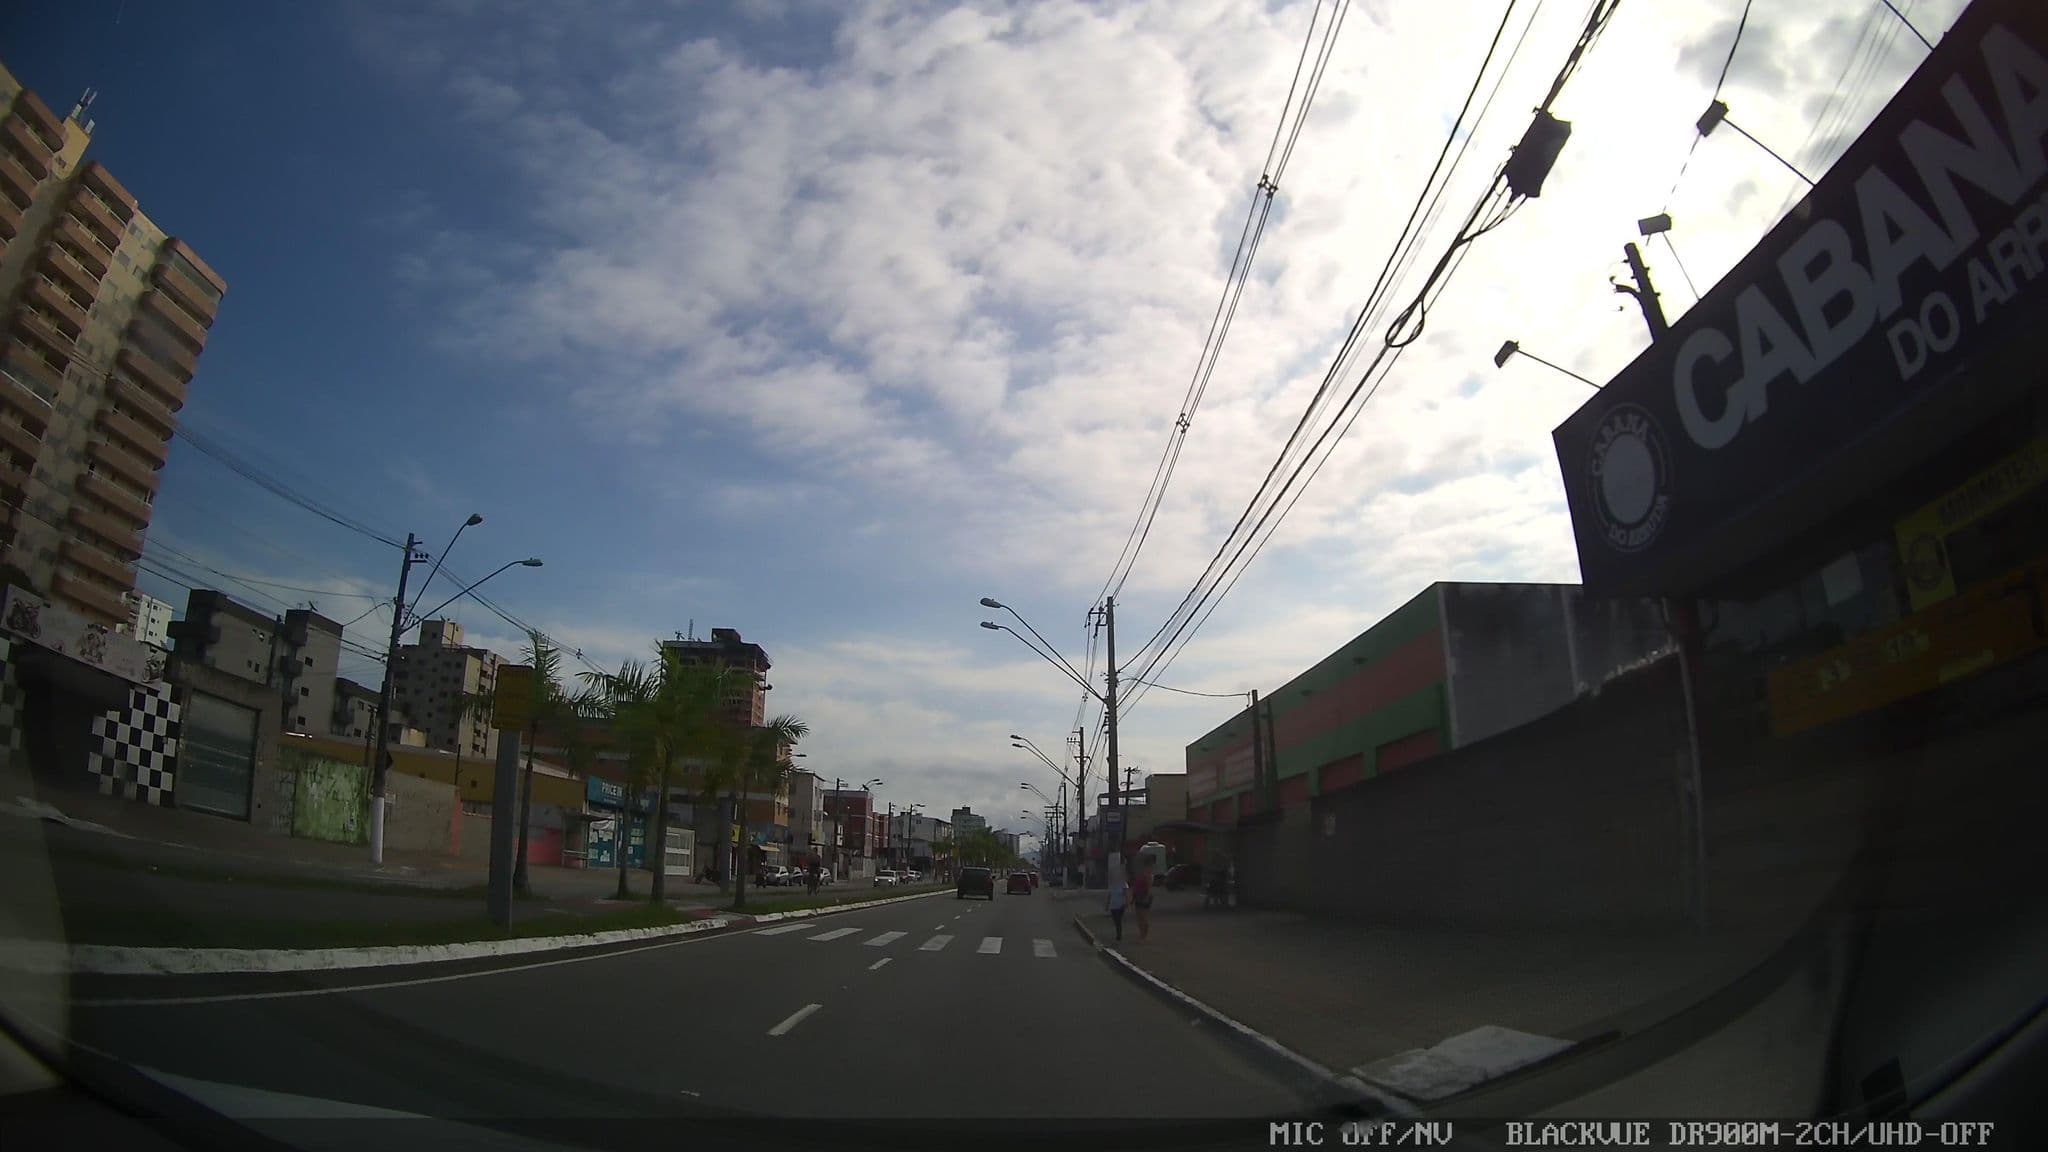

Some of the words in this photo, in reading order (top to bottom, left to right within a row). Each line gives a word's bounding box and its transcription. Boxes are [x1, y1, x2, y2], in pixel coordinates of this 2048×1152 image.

[1673, 22, 2048, 450] CABANA
[1887, 290, 1960, 382] DO
[1967, 188, 2048, 326] ARR
